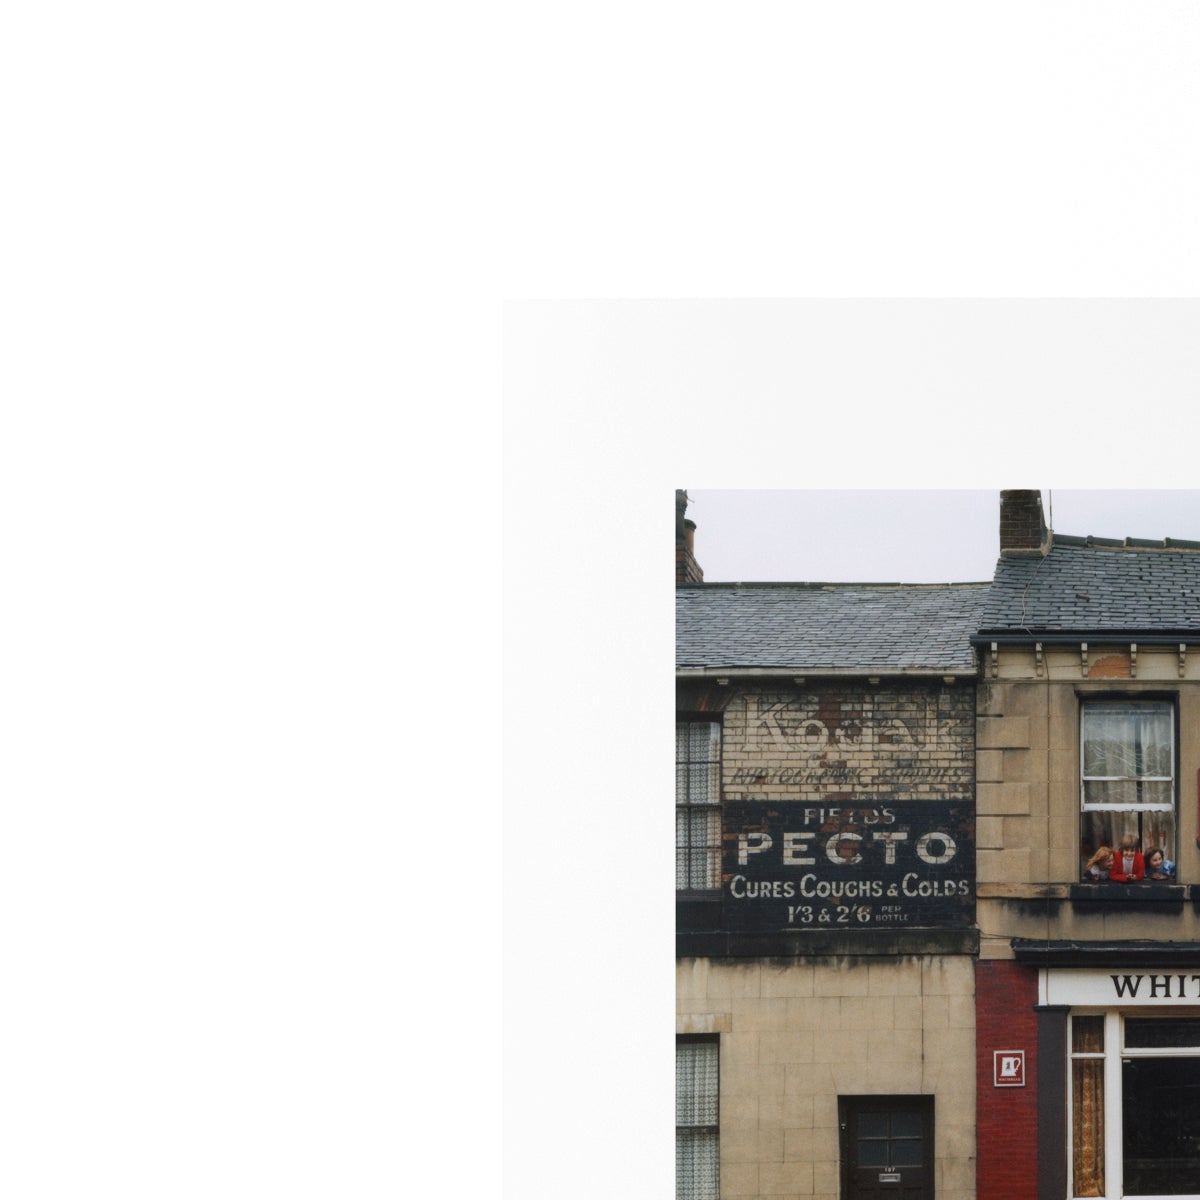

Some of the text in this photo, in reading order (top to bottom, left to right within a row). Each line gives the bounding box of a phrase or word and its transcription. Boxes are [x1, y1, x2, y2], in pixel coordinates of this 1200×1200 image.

[737, 831, 957, 866] PECTO
[886, 883, 899, 897] &
[818, 908, 831, 923] &
[881, 905, 903, 913] PER
[875, 914, 909, 922] BOTTLE
